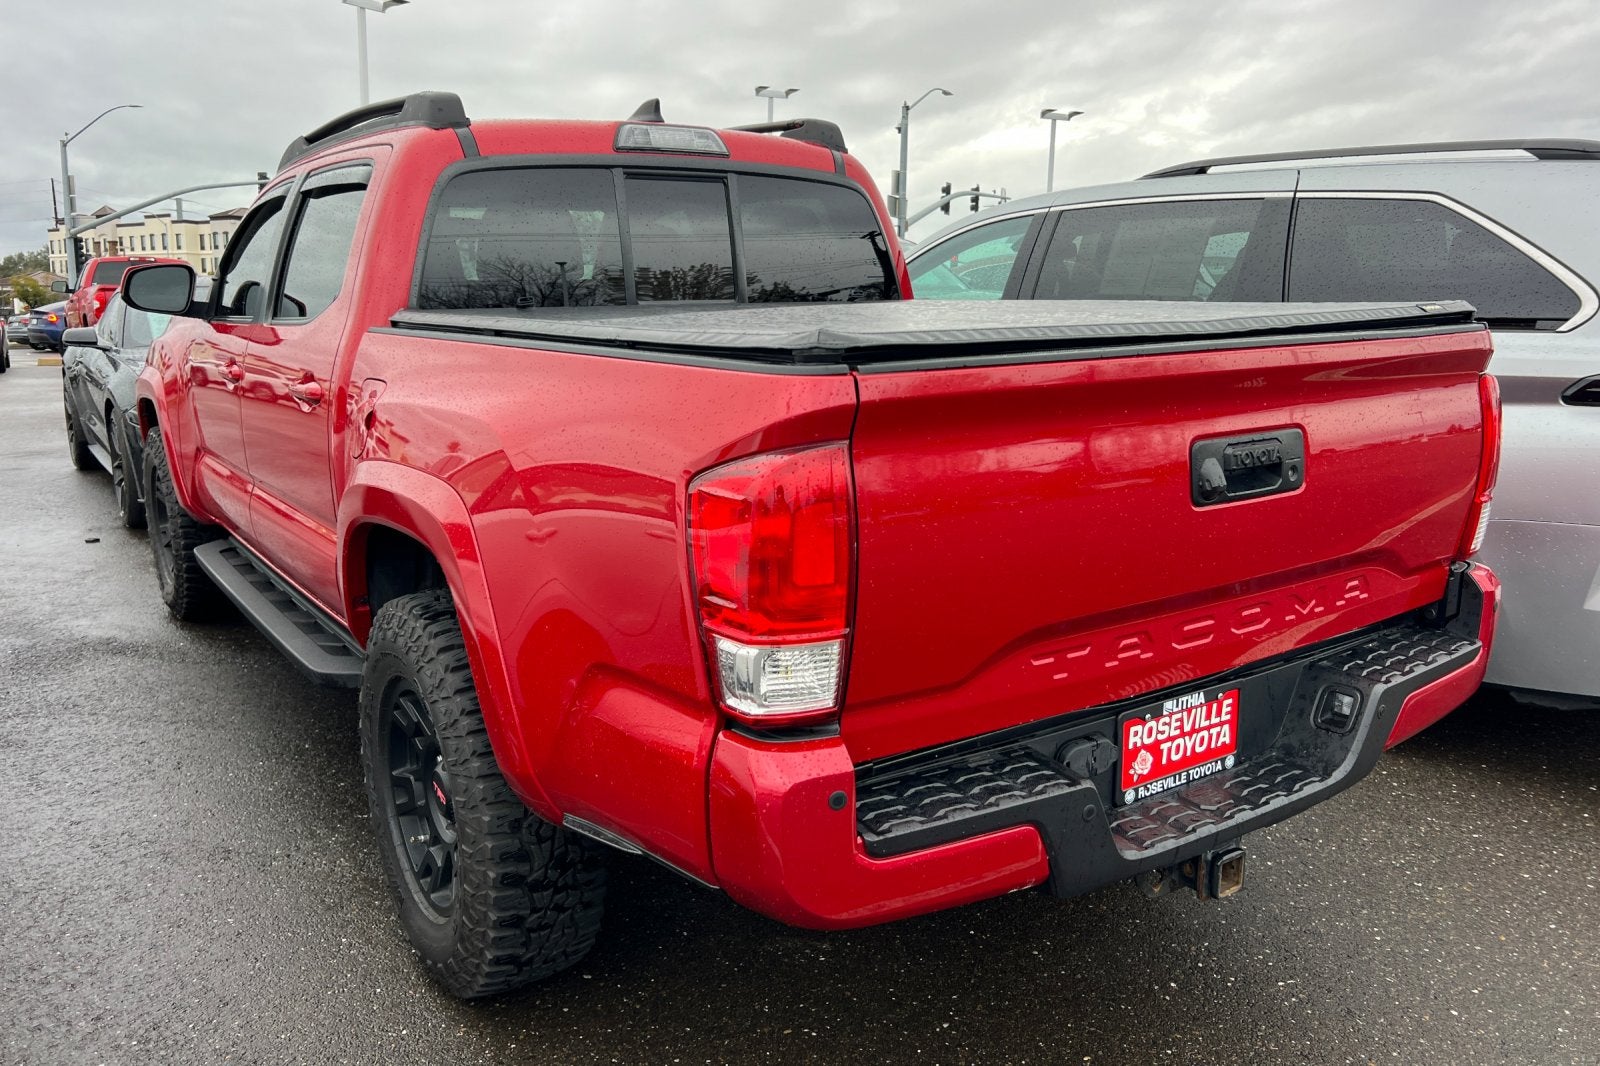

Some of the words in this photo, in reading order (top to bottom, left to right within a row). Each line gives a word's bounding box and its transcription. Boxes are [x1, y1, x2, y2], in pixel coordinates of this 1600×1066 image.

[1233, 446, 1281, 465] TOYOTA
[1030, 577, 1369, 680] TACOMA
[1172, 691, 1206, 711] LITHIA
[1128, 698, 1233, 750] ROSEVILLE
[1159, 723, 1231, 765] TOYOTA
[1138, 772, 1188, 799] ROSEVILLE
[1188, 760, 1223, 781] TOYOTA
